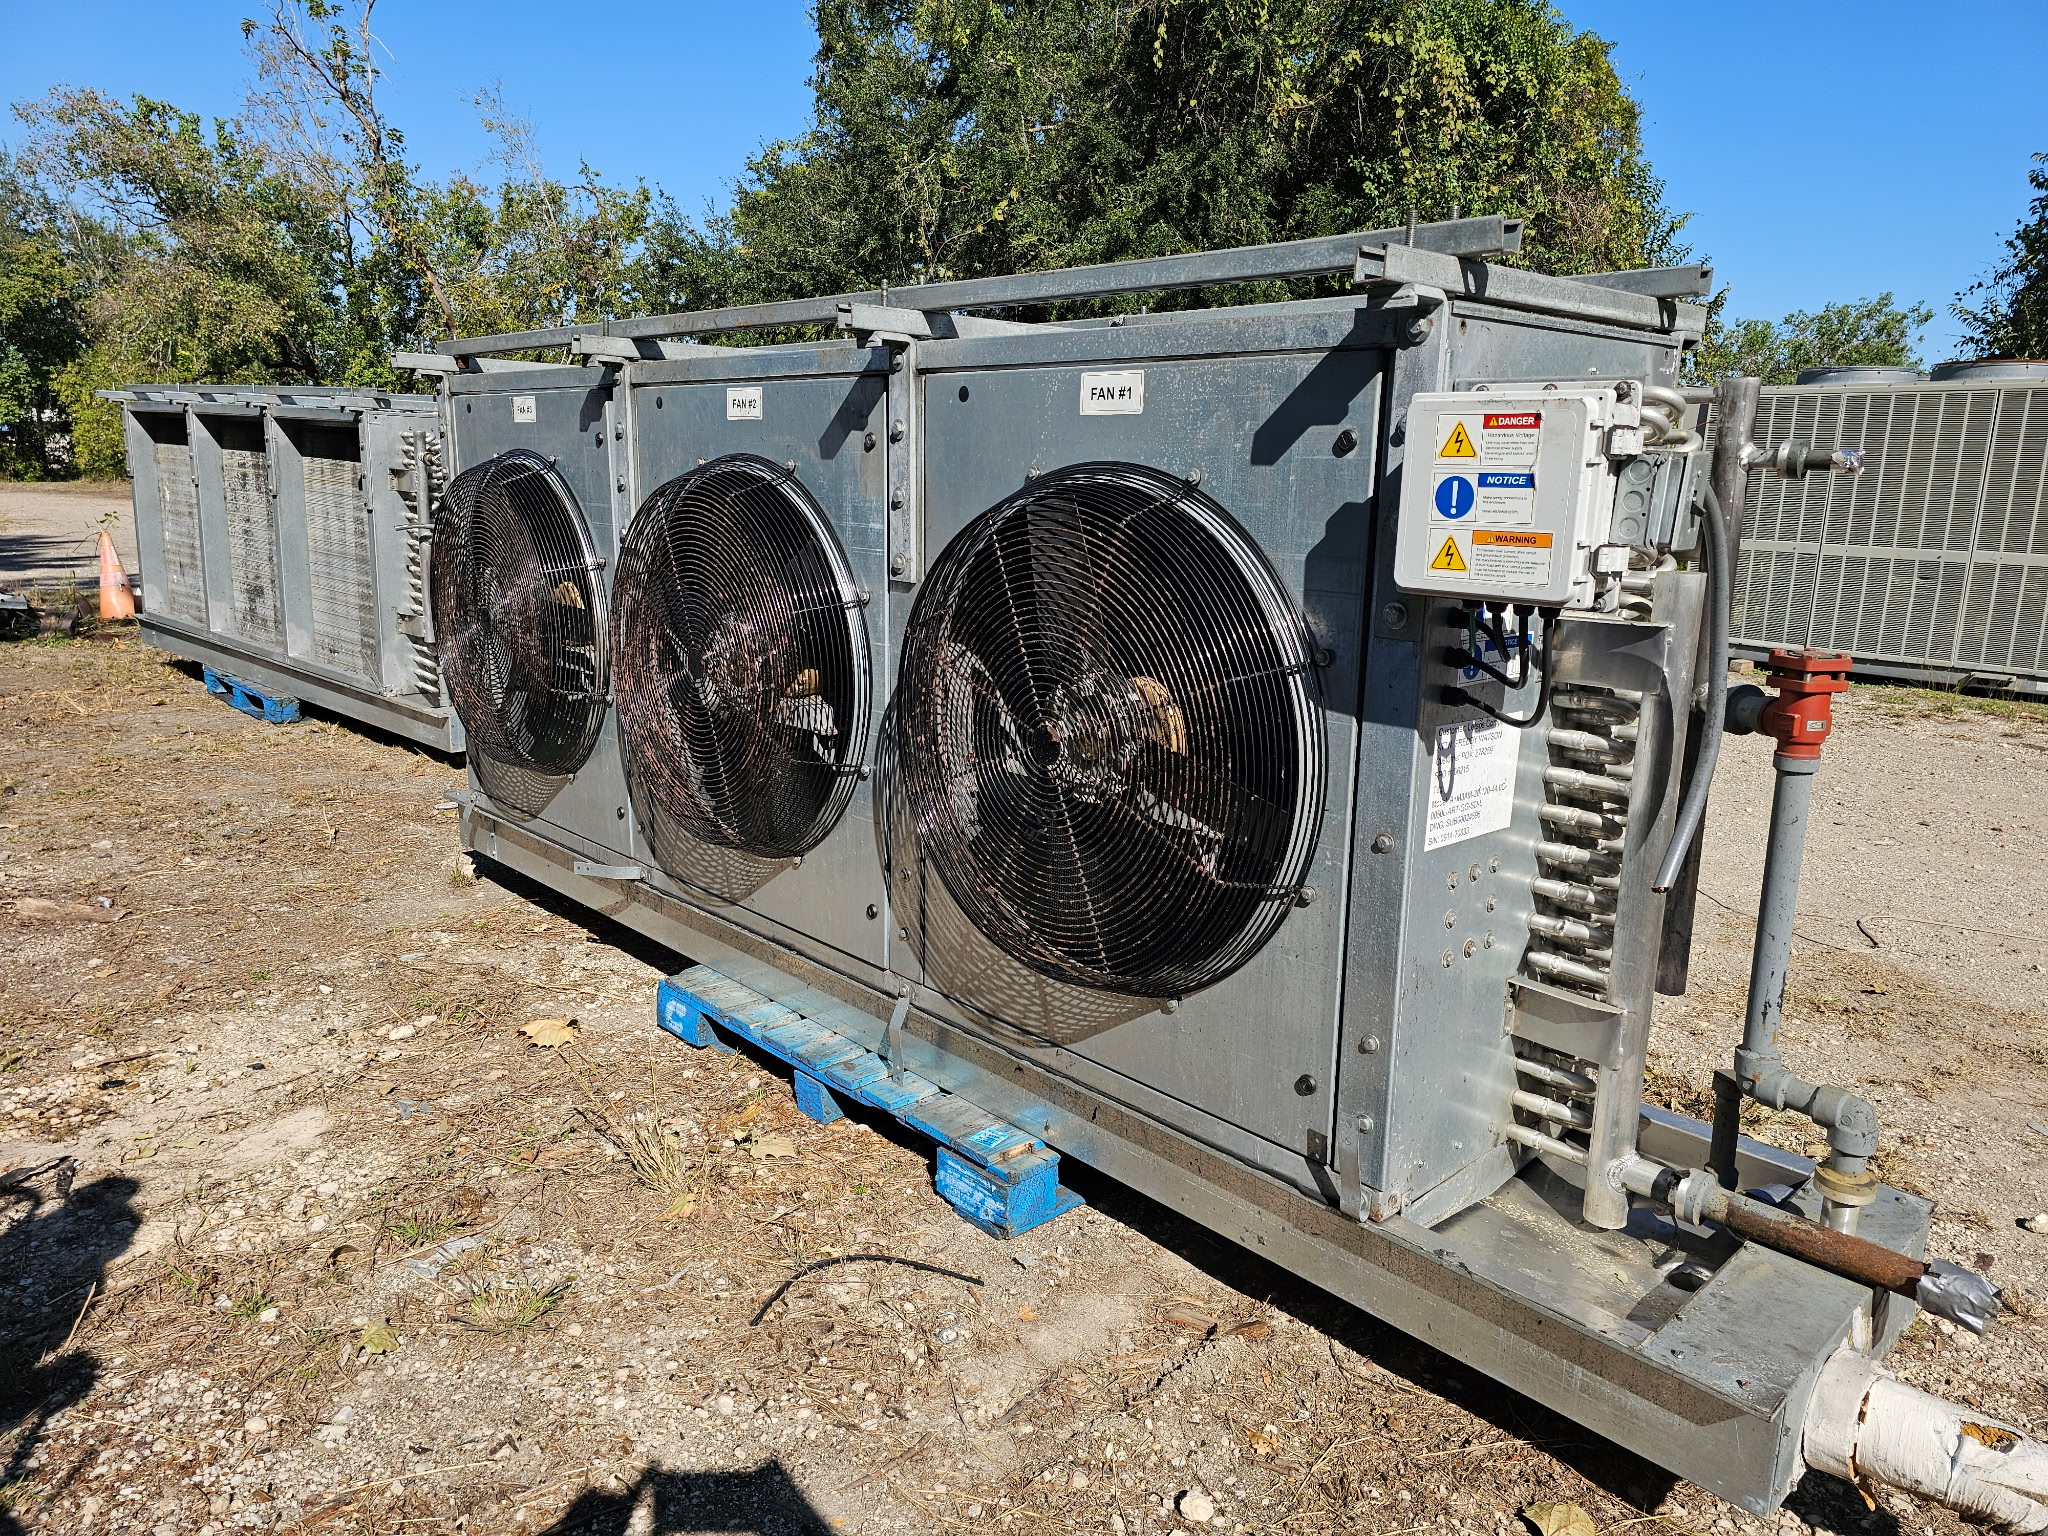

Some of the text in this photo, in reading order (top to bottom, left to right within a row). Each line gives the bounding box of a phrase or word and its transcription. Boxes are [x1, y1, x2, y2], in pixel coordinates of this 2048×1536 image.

[1090, 386, 1132, 401] FAN #1
[732, 398, 757, 409] FAN #2
[1498, 416, 1535, 425] DANGER
[1486, 476, 1527, 485] NOTICE
[1495, 535, 1537, 545] WARNING
